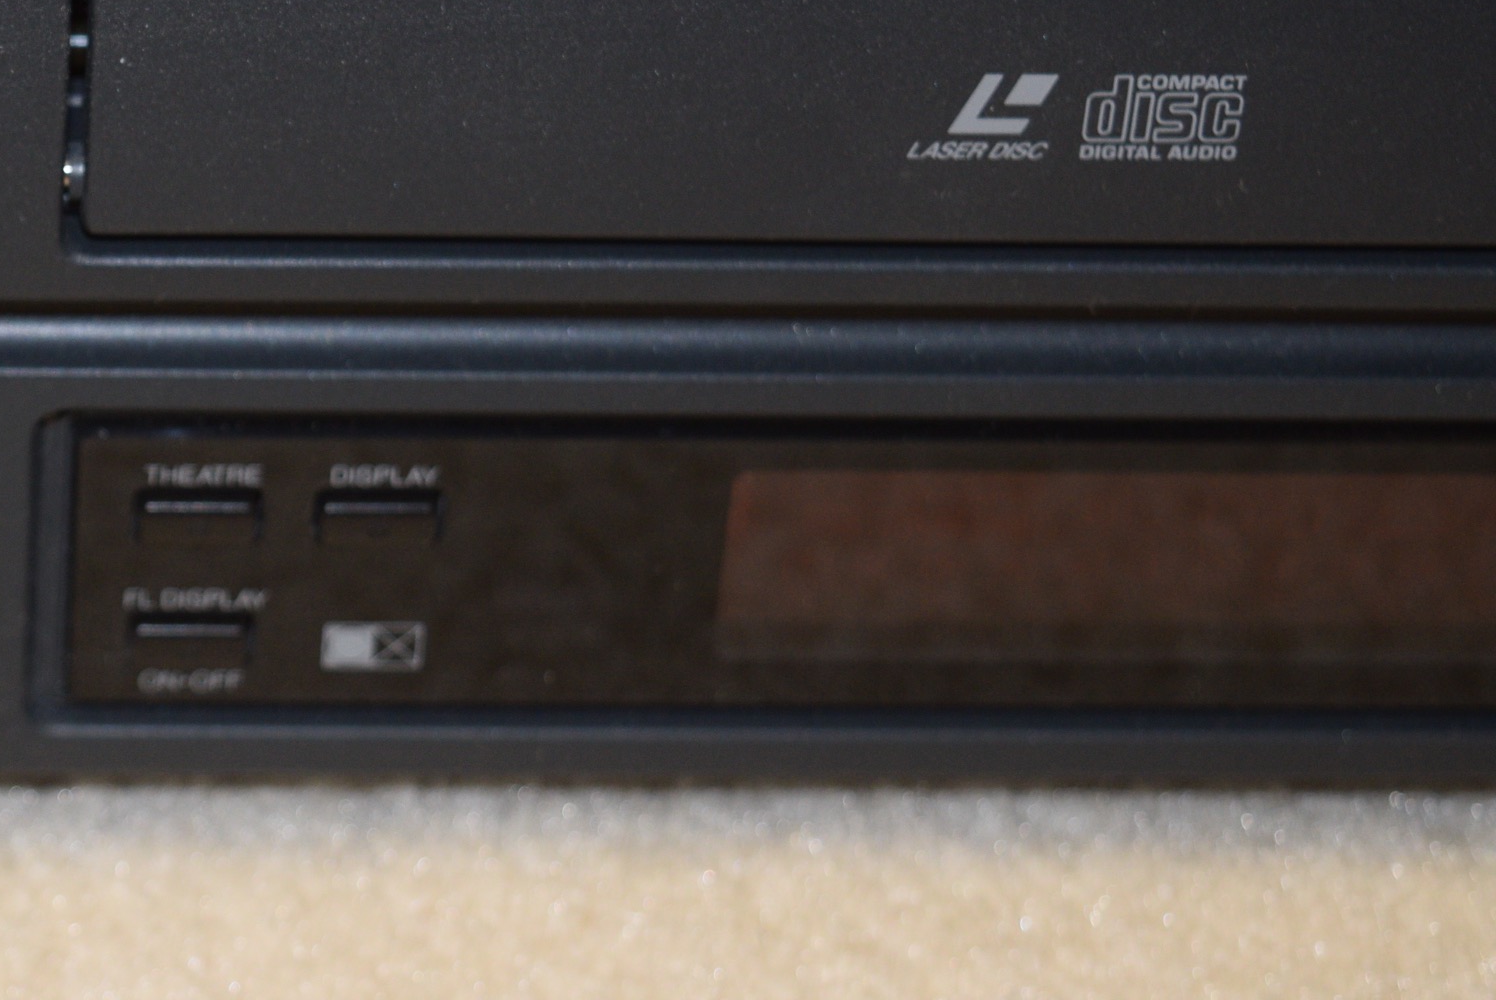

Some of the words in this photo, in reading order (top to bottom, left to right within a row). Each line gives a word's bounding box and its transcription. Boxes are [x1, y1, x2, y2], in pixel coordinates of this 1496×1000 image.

[1136, 75, 1247, 91] COMPACT
[1081, 75, 1245, 144] disc
[906, 141, 988, 161] LASER
[987, 142, 1049, 161] DISC
[1078, 145, 1161, 161] DIGITAL
[1167, 145, 1238, 161] AUDIO
[144, 462, 264, 489] THEATRE
[329, 463, 441, 489] DISPLAY
[158, 586, 270, 613] DISPLAY
